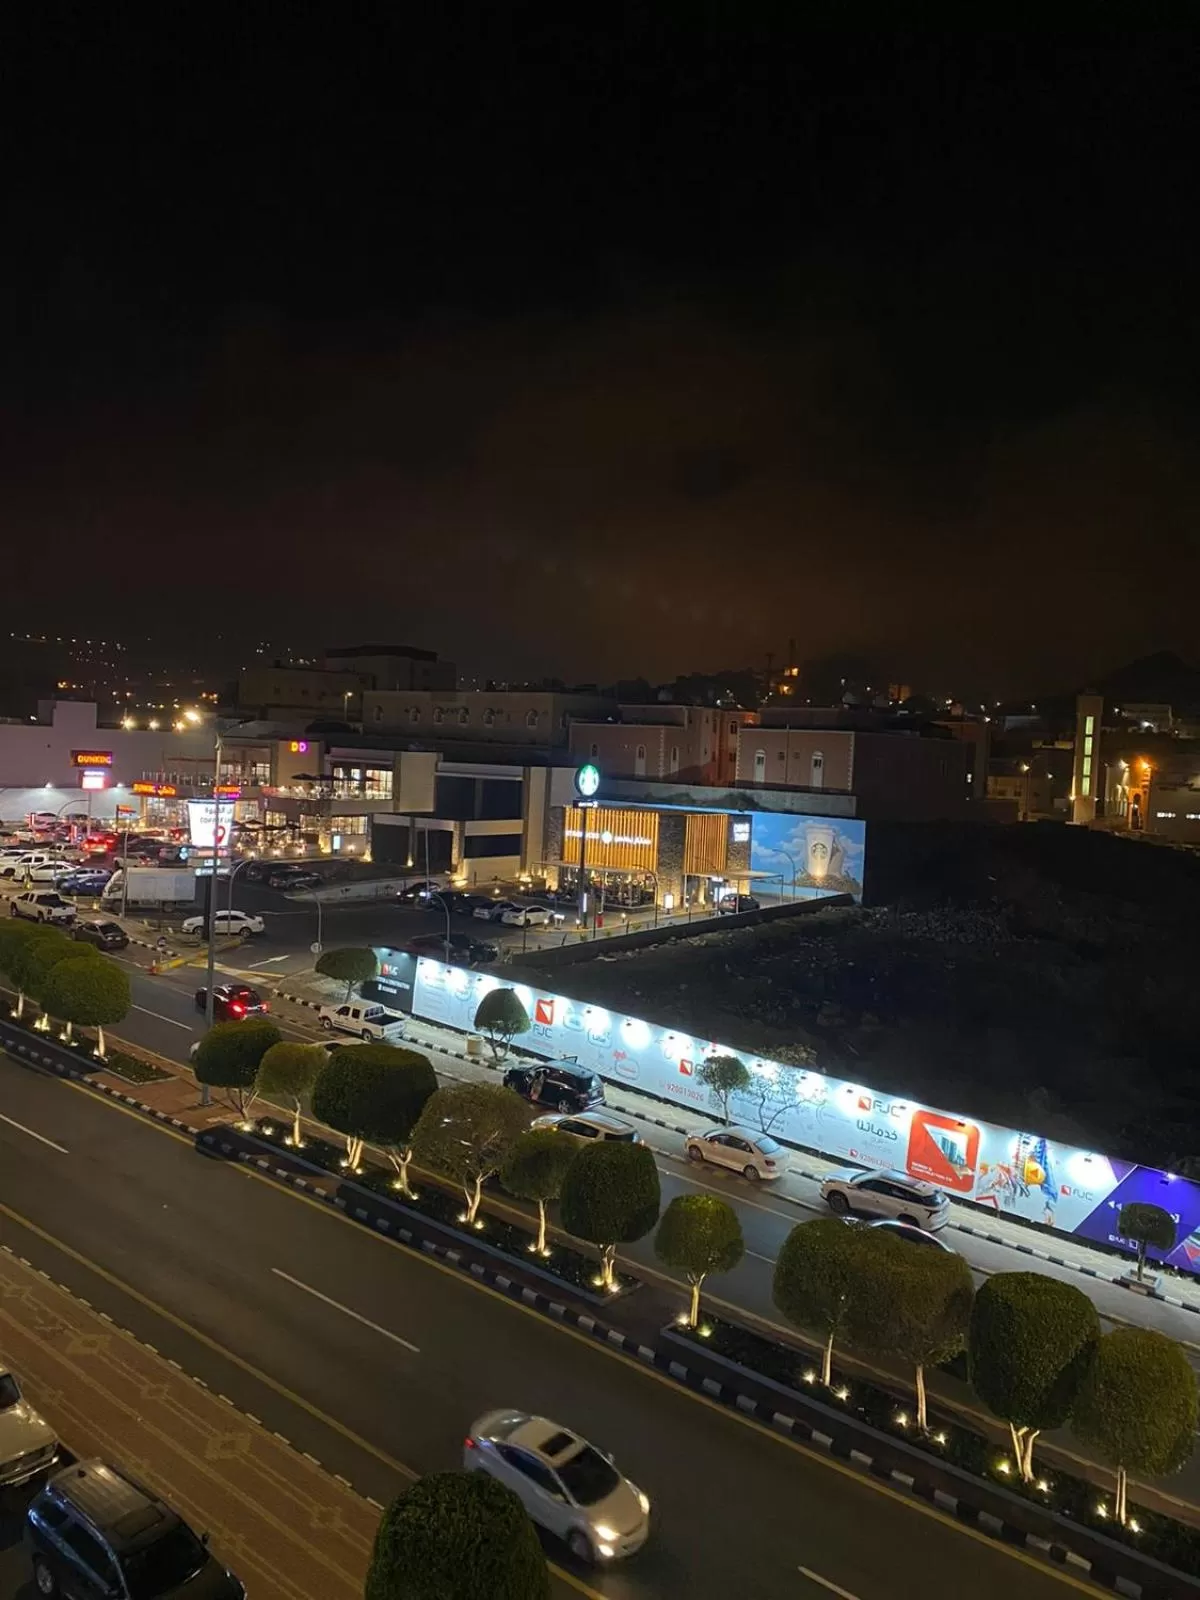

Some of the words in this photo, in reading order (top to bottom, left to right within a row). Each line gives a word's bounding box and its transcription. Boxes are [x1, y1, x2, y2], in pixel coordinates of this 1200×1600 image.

[532, 1022, 553, 1039] FJC
[873, 1100, 901, 1118] FJC
[856, 1119, 898, 1141] خدماتنا
